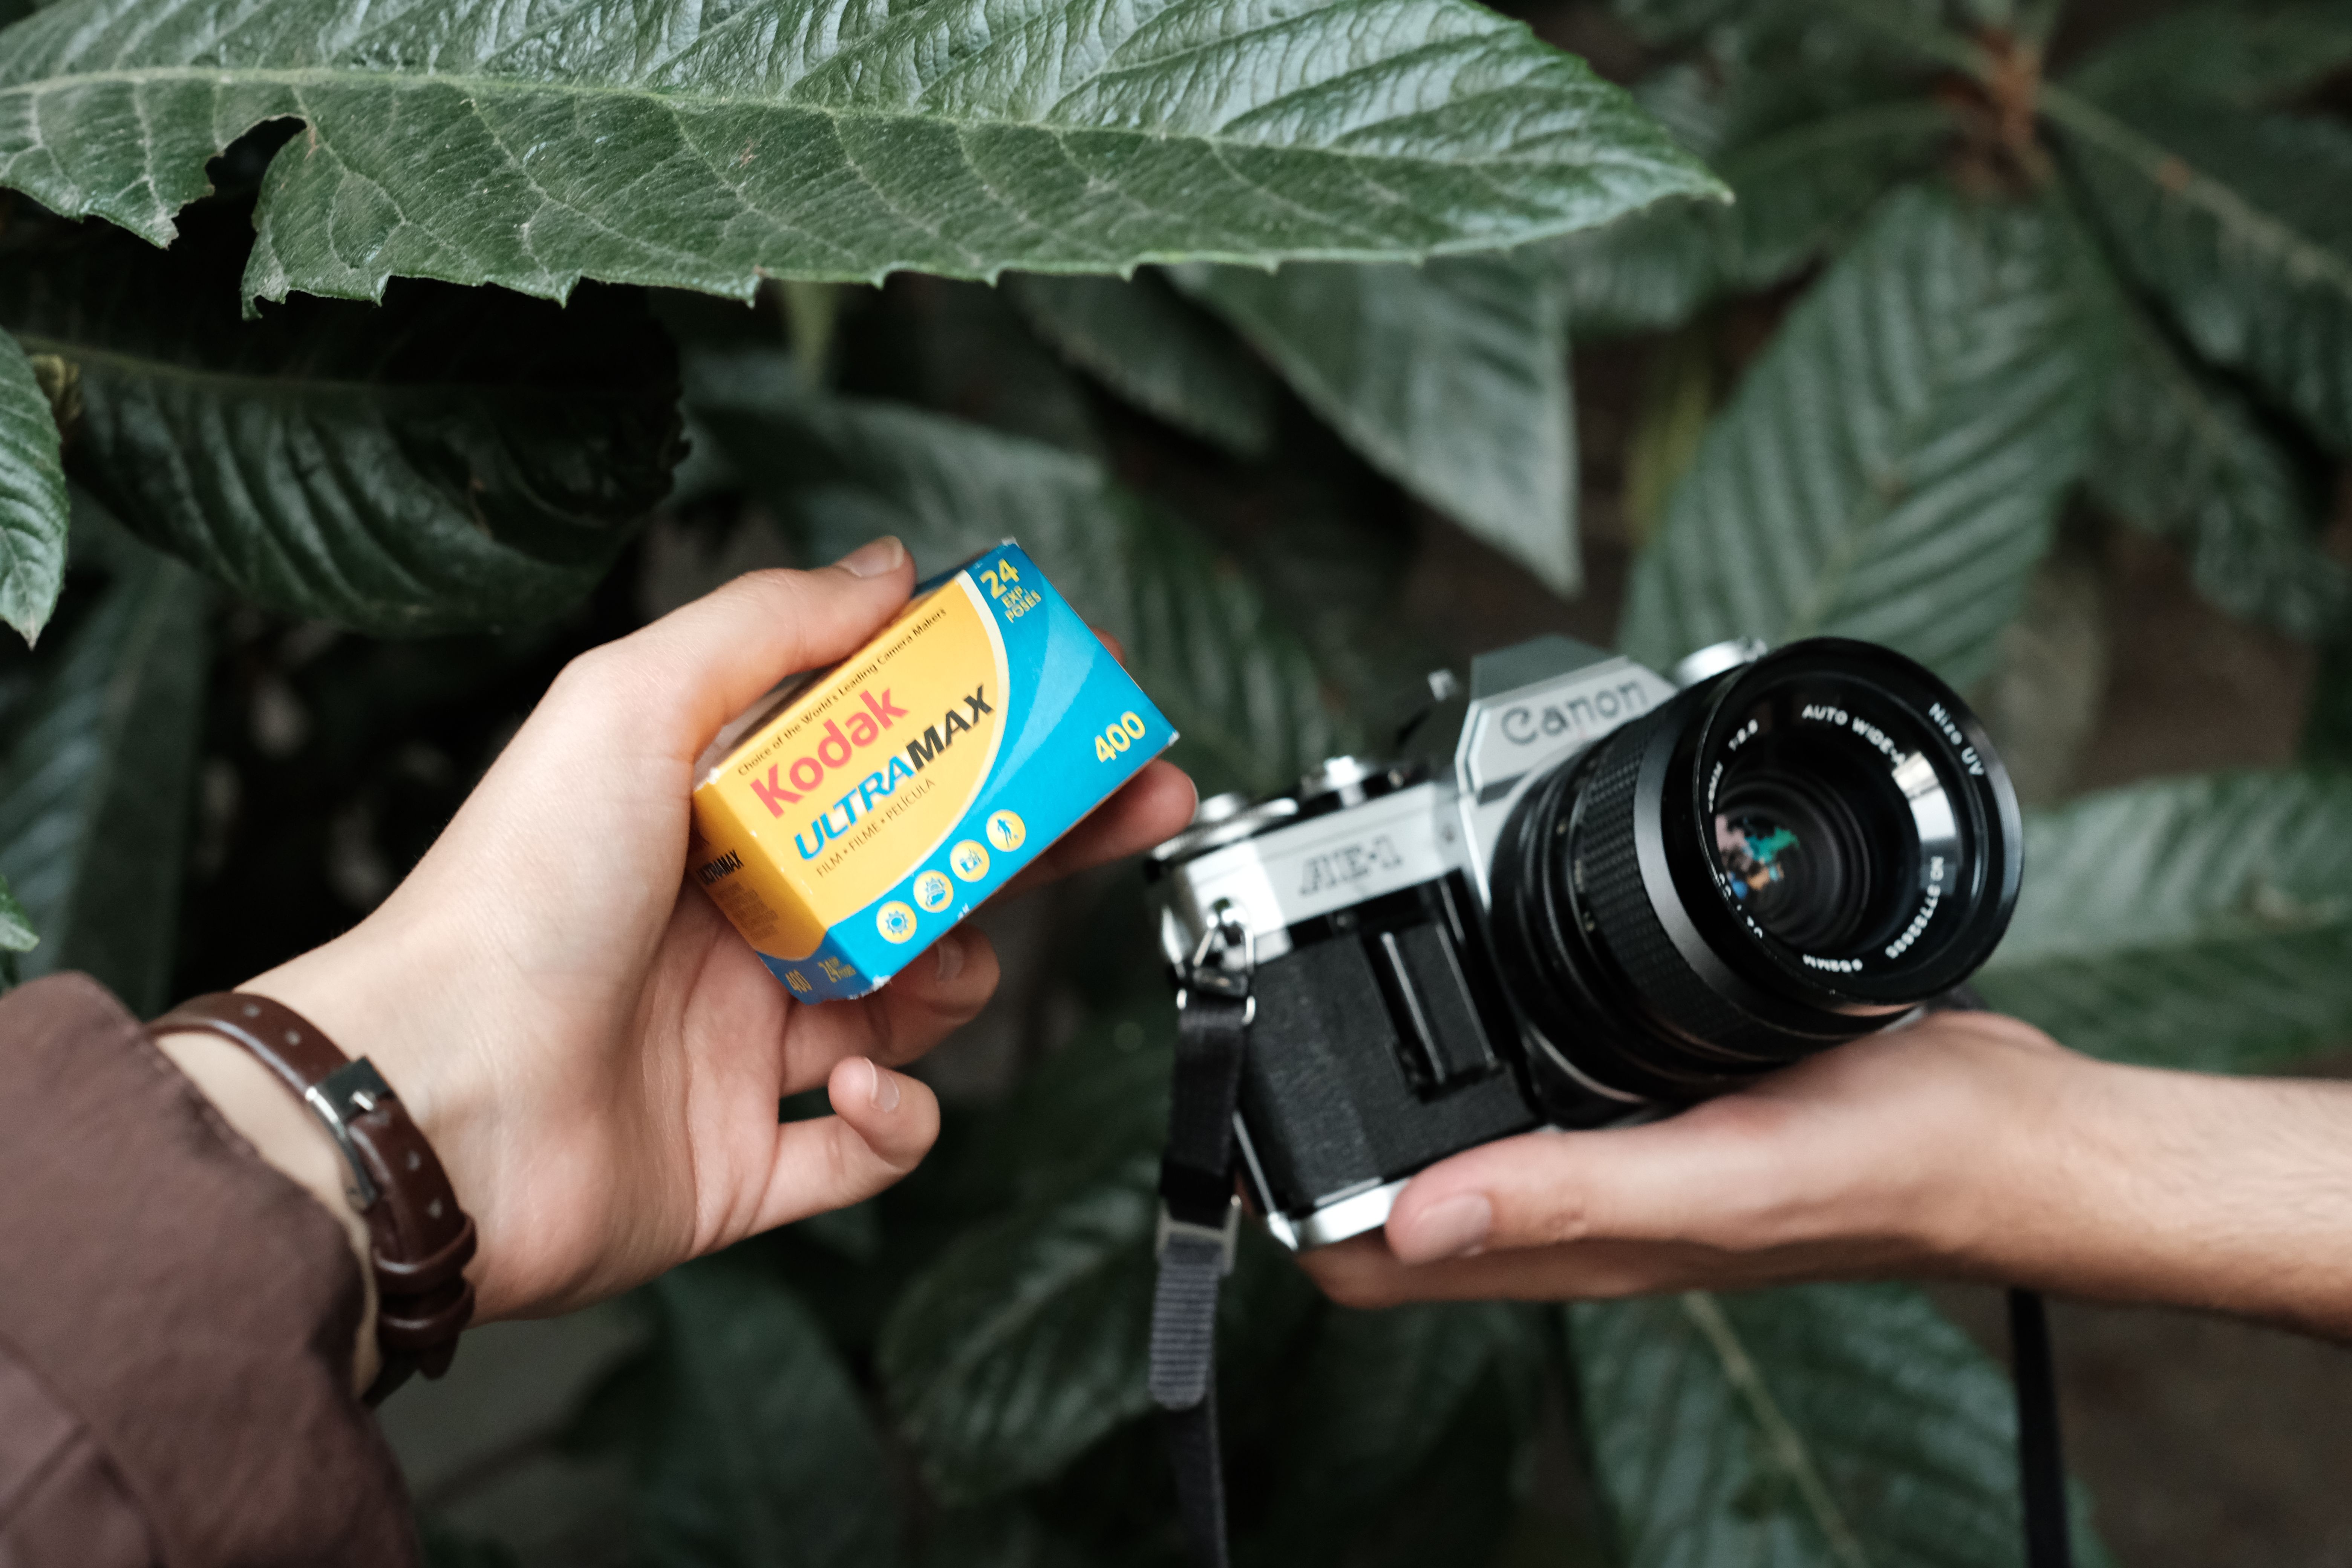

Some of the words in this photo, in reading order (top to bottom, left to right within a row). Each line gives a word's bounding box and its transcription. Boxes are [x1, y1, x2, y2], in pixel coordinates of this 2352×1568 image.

[979, 558, 1020, 599] 24
[1004, 589, 1041, 623] POSES
[738, 747, 771, 776] Choice
[773, 736, 784, 749] of
[785, 723, 801, 739] the
[801, 695, 839, 724] World's
[838, 662, 879, 696] Leading
[877, 634, 913, 665] Camera
[912, 608, 947, 637] Makers
[1501, 680, 1648, 745] Canon
[1802, 704, 1848, 726] AUTO
[749, 688, 909, 818] Kodak
[1095, 710, 1146, 763] 400
[1961, 746, 1984, 776] UV
[816, 852, 844, 878] FILM
[848, 822, 881, 851] FILME
[886, 777, 936, 821] PELÍCULA
[1298, 835, 1404, 896] AE-1
[785, 969, 813, 993] 400
